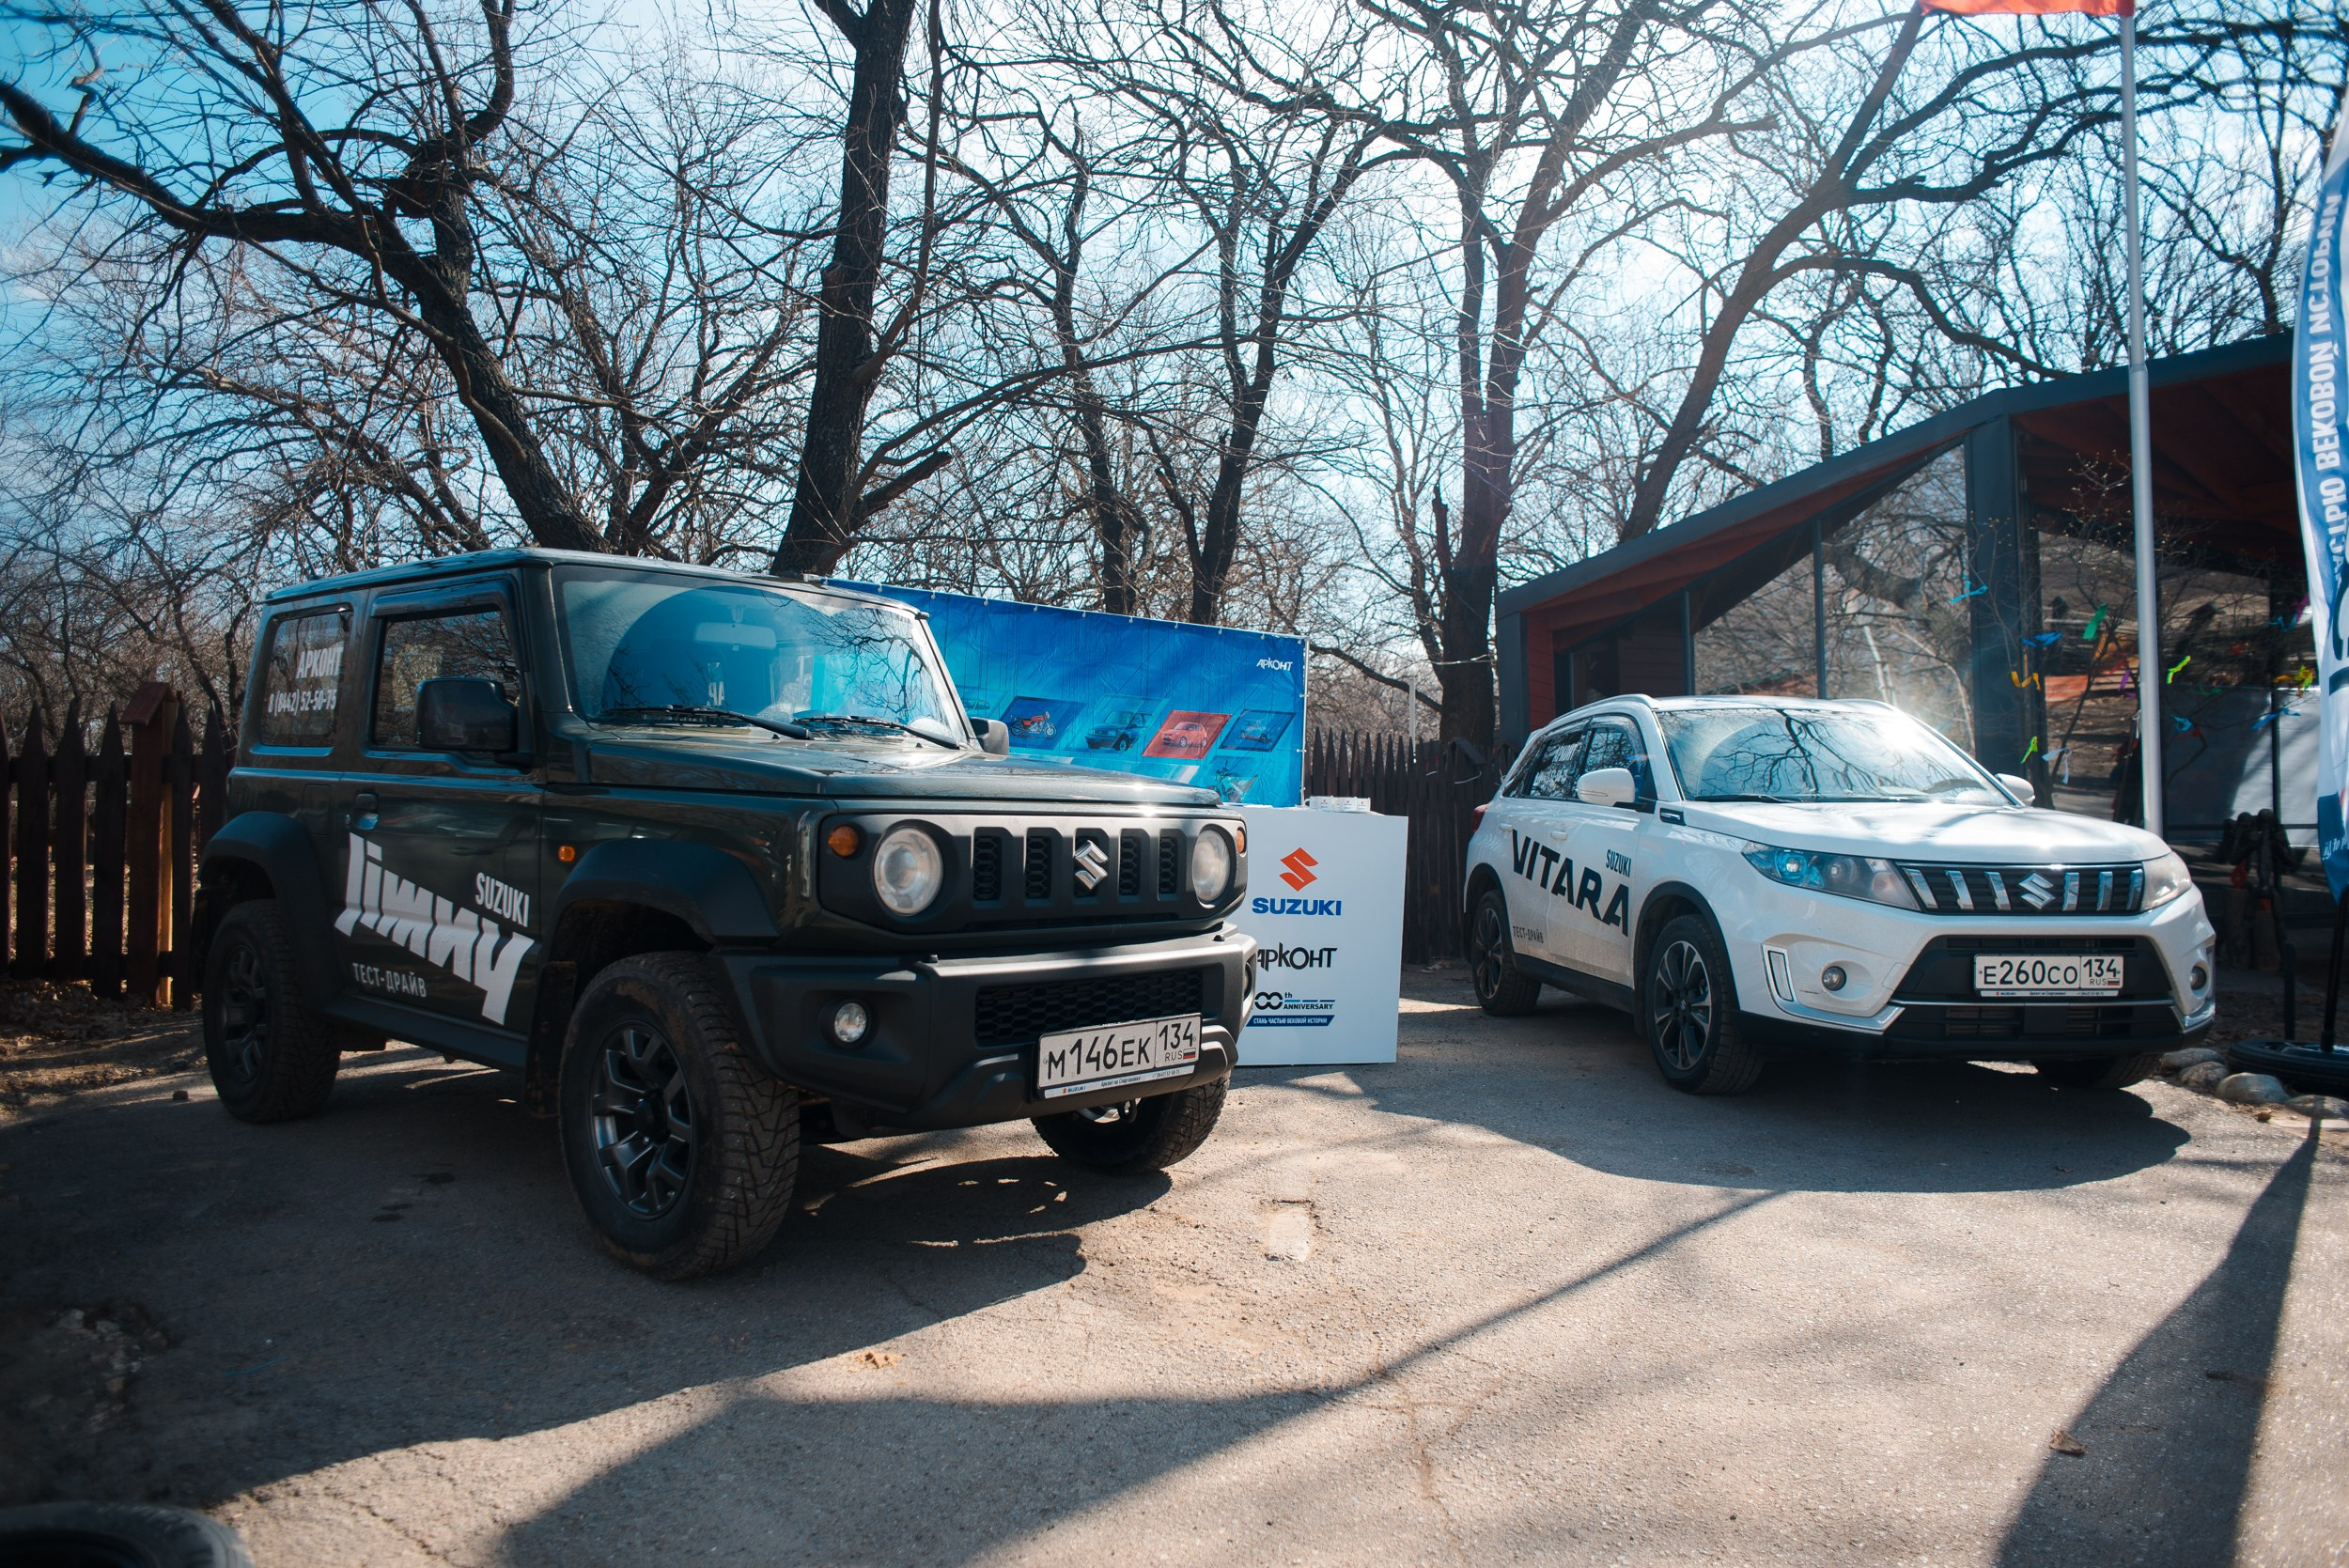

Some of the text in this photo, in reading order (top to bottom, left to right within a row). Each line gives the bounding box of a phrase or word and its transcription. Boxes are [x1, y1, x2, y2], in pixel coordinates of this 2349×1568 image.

[296, 646, 344, 679] АРКОНТ
[268, 689, 337, 717] 8 (8442) 52-50-75
[1605, 848, 1632, 877] SUZUKI
[1512, 829, 1629, 938] VITARA
[475, 872, 530, 927] SUZUKI
[1252, 897, 1342, 916] SUZUKI
[352, 962, 428, 998] ТЕСТ-ДРАЙВ
[1983, 959, 2117, 985] Е260СО 134
[1047, 1022, 1193, 1079] М146ЕК 134
[1165, 1050, 1183, 1062] RUS
